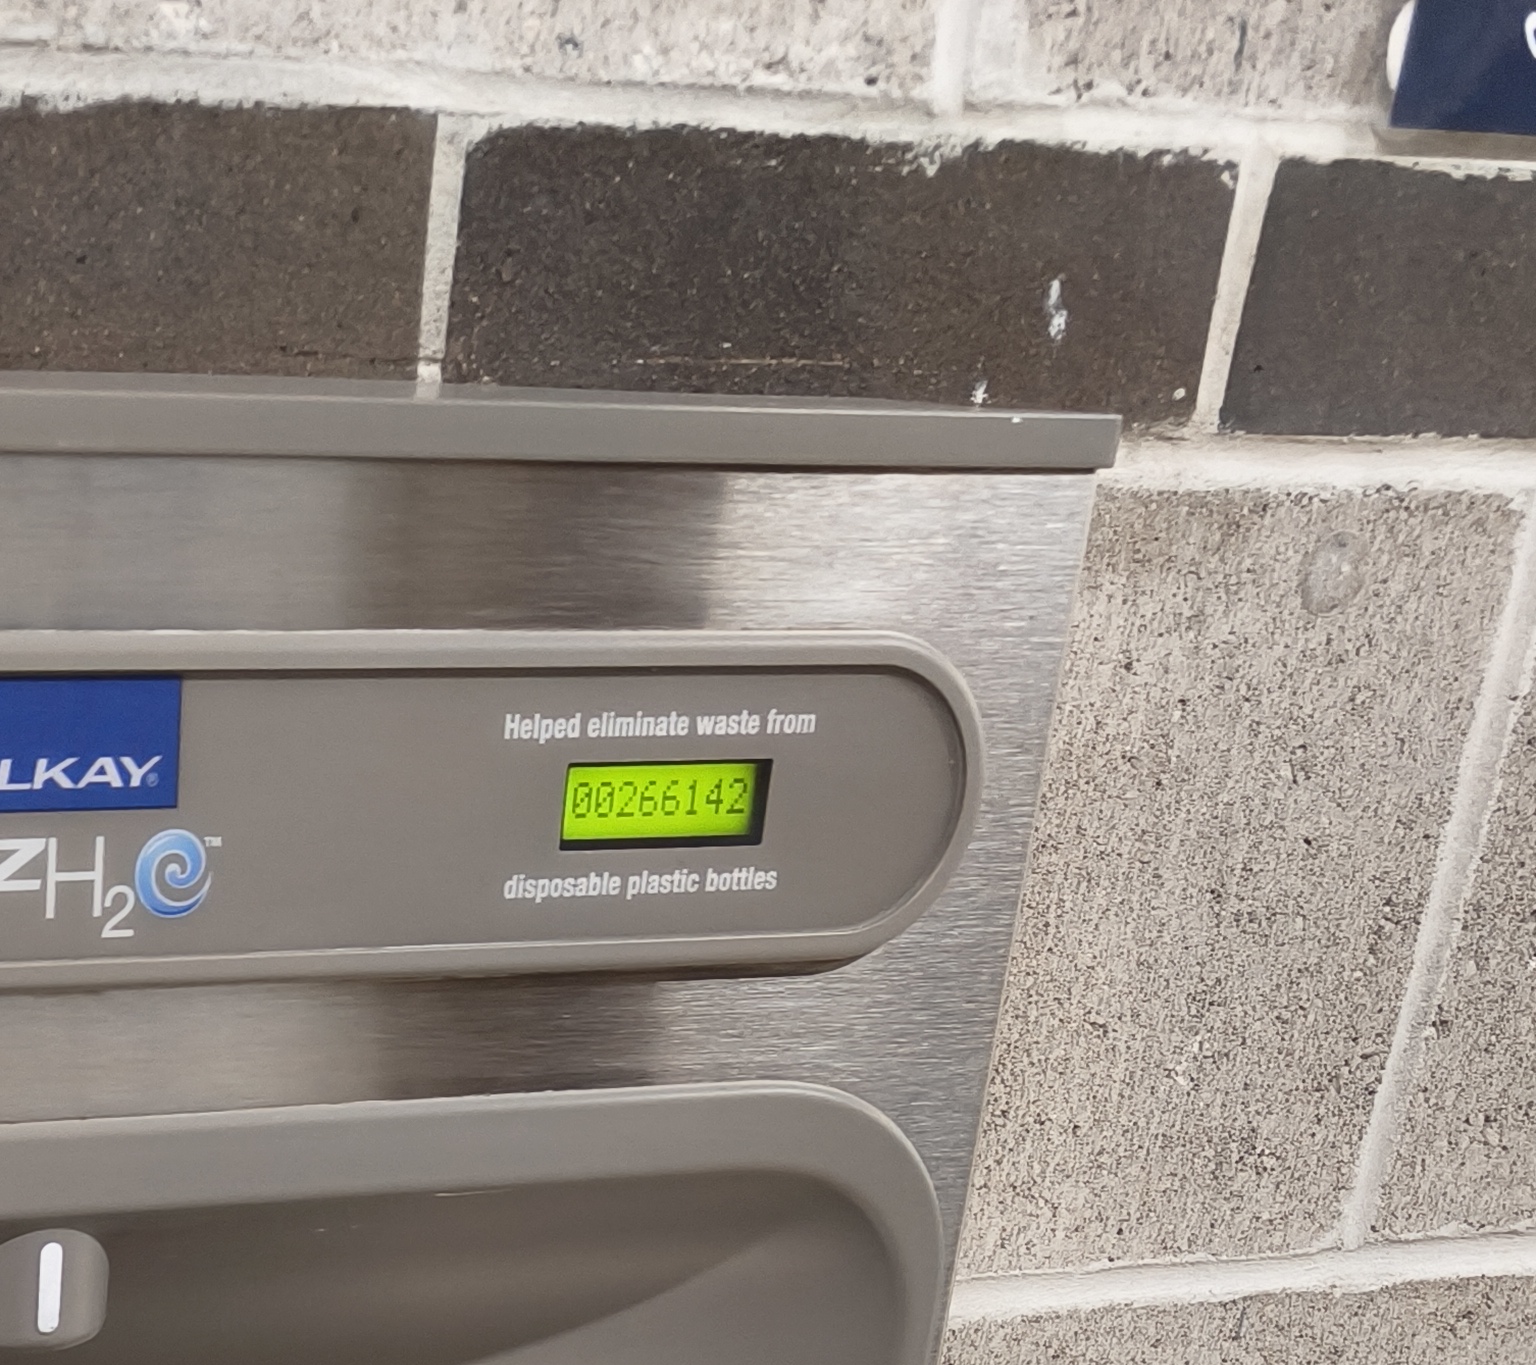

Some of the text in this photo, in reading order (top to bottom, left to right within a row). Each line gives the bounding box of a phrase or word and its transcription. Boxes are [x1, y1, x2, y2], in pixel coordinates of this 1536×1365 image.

[504, 708, 817, 744] Helped eliminate waste from
[571, 777, 748, 819] 00266142
[504, 866, 778, 903] disposable plastic bottles
